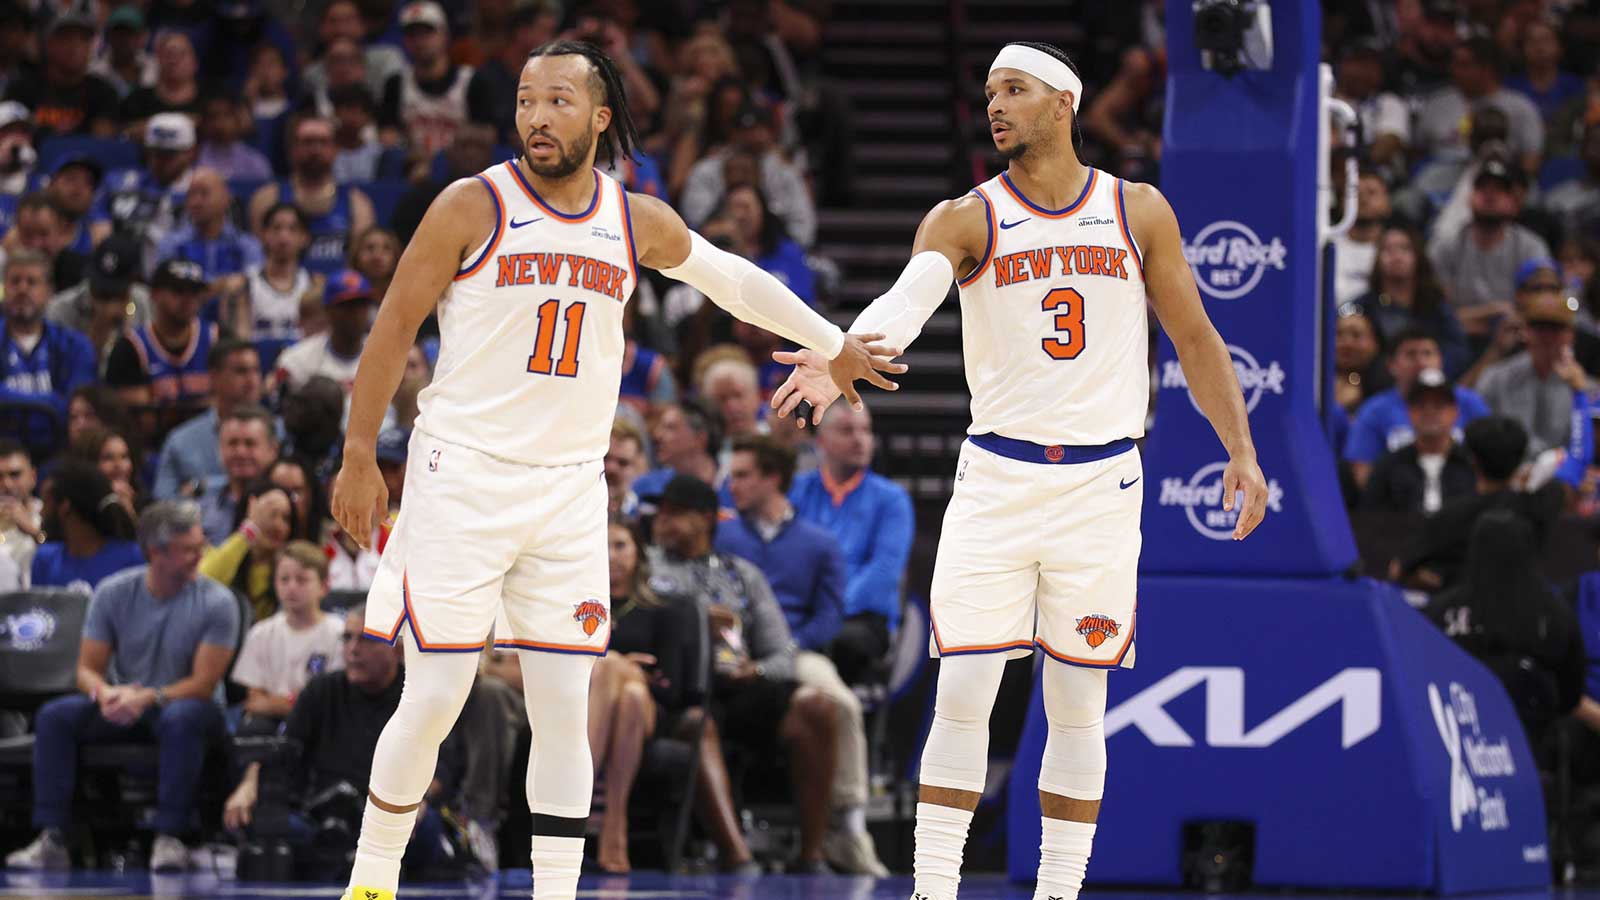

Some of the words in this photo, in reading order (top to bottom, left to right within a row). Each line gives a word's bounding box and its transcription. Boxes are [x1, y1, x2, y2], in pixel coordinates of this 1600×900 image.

[993, 247, 1053, 288] NEW
[1055, 245, 1128, 280] YORK
[1226, 236, 1287, 270] Rock
[495, 252, 564, 288] NEW
[566, 253, 628, 303] YORK
[1210, 269, 1241, 287] BET
[527, 298, 587, 378] 11
[1041, 287, 1086, 360] 3
[1159, 477, 1224, 506] Hard
[1075, 615, 1118, 637] KNICKS
[1449, 681, 1481, 736] City
